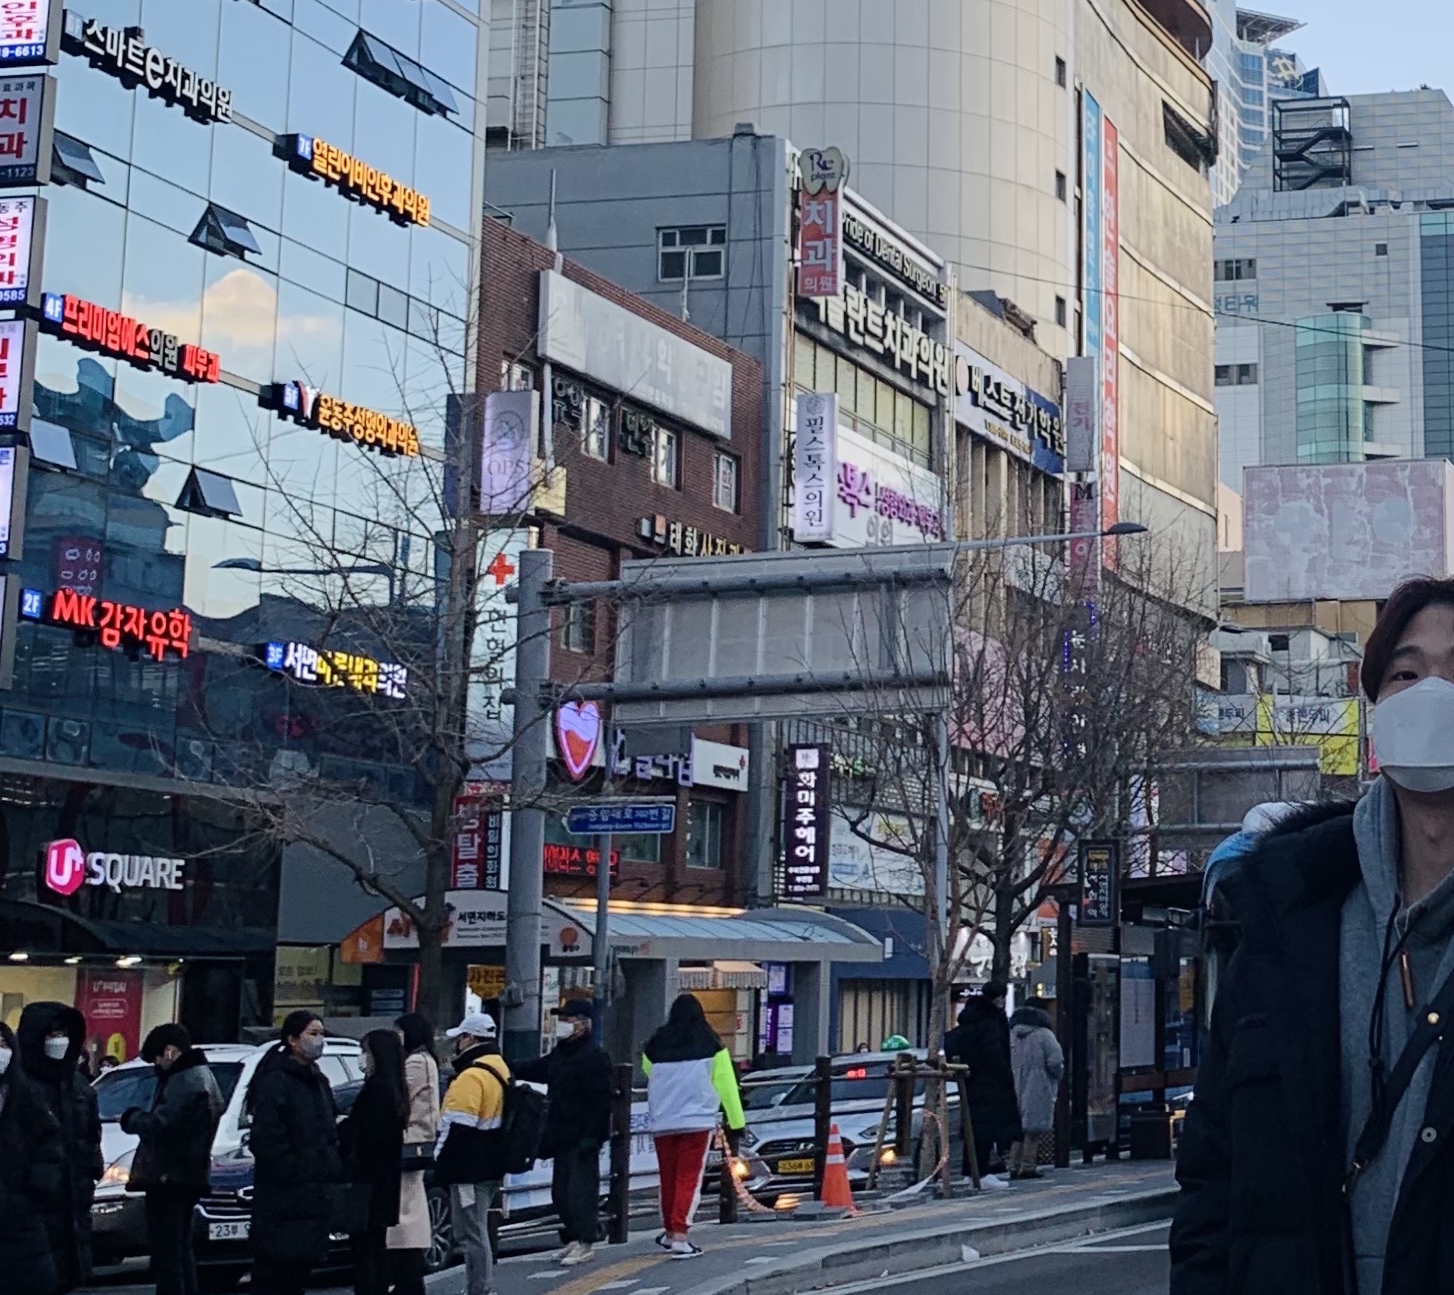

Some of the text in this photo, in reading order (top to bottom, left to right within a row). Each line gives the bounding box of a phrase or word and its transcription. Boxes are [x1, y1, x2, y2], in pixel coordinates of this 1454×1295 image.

[84, 20, 234, 123] 스마트e치과의원
[312, 137, 431, 227] 열린이비인후과의원
[804, 200, 836, 273] 치과
[841, 210, 864, 244] Pride
[864, 234, 875, 252] of
[876, 235, 903, 272] Dental
[903, 258, 937, 298] Surgeon
[804, 276, 833, 292] 의원
[184, 343, 220, 383] 피부과
[486, 460, 525, 476] OPS
[24, 592, 39, 614] 2F
[794, 772, 817, 863] 화미주헤어
[88, 852, 185, 894] SQUARE
